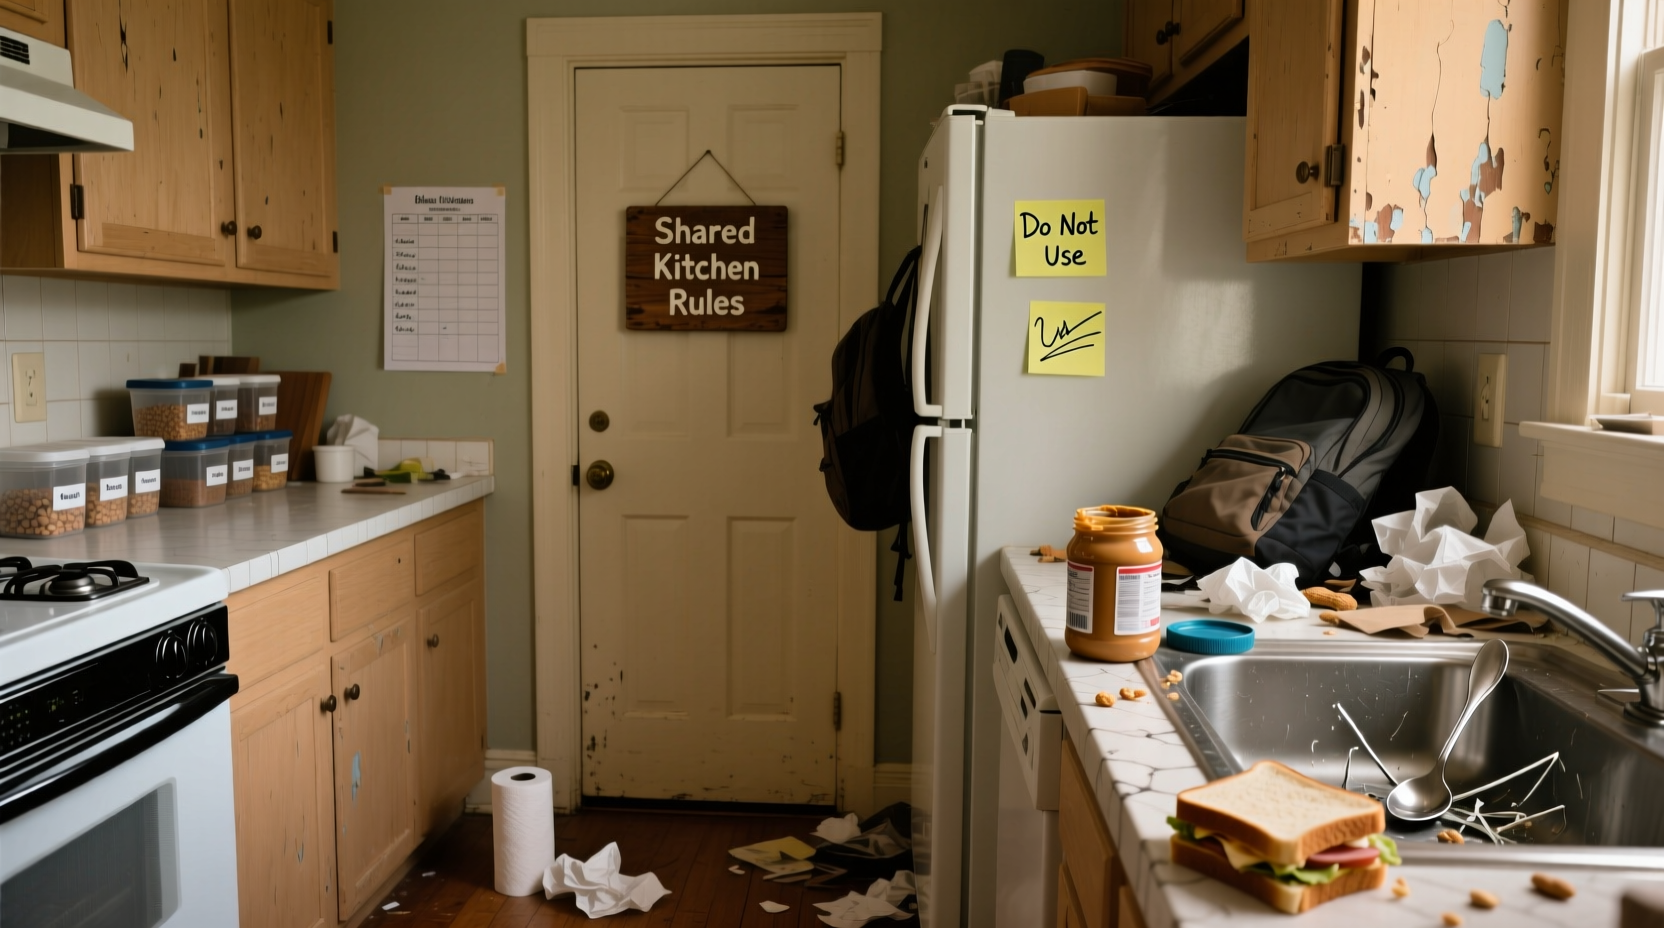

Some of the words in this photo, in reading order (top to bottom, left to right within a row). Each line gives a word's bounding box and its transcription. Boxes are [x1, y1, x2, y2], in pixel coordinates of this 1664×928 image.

[654, 216, 755, 245] Shared
[1020, 211, 1052, 239] Do
[1060, 210, 1099, 236] Not
[654, 252, 760, 281] Kitchen
[1045, 245, 1087, 267] Use
[669, 288, 745, 316] Rules
